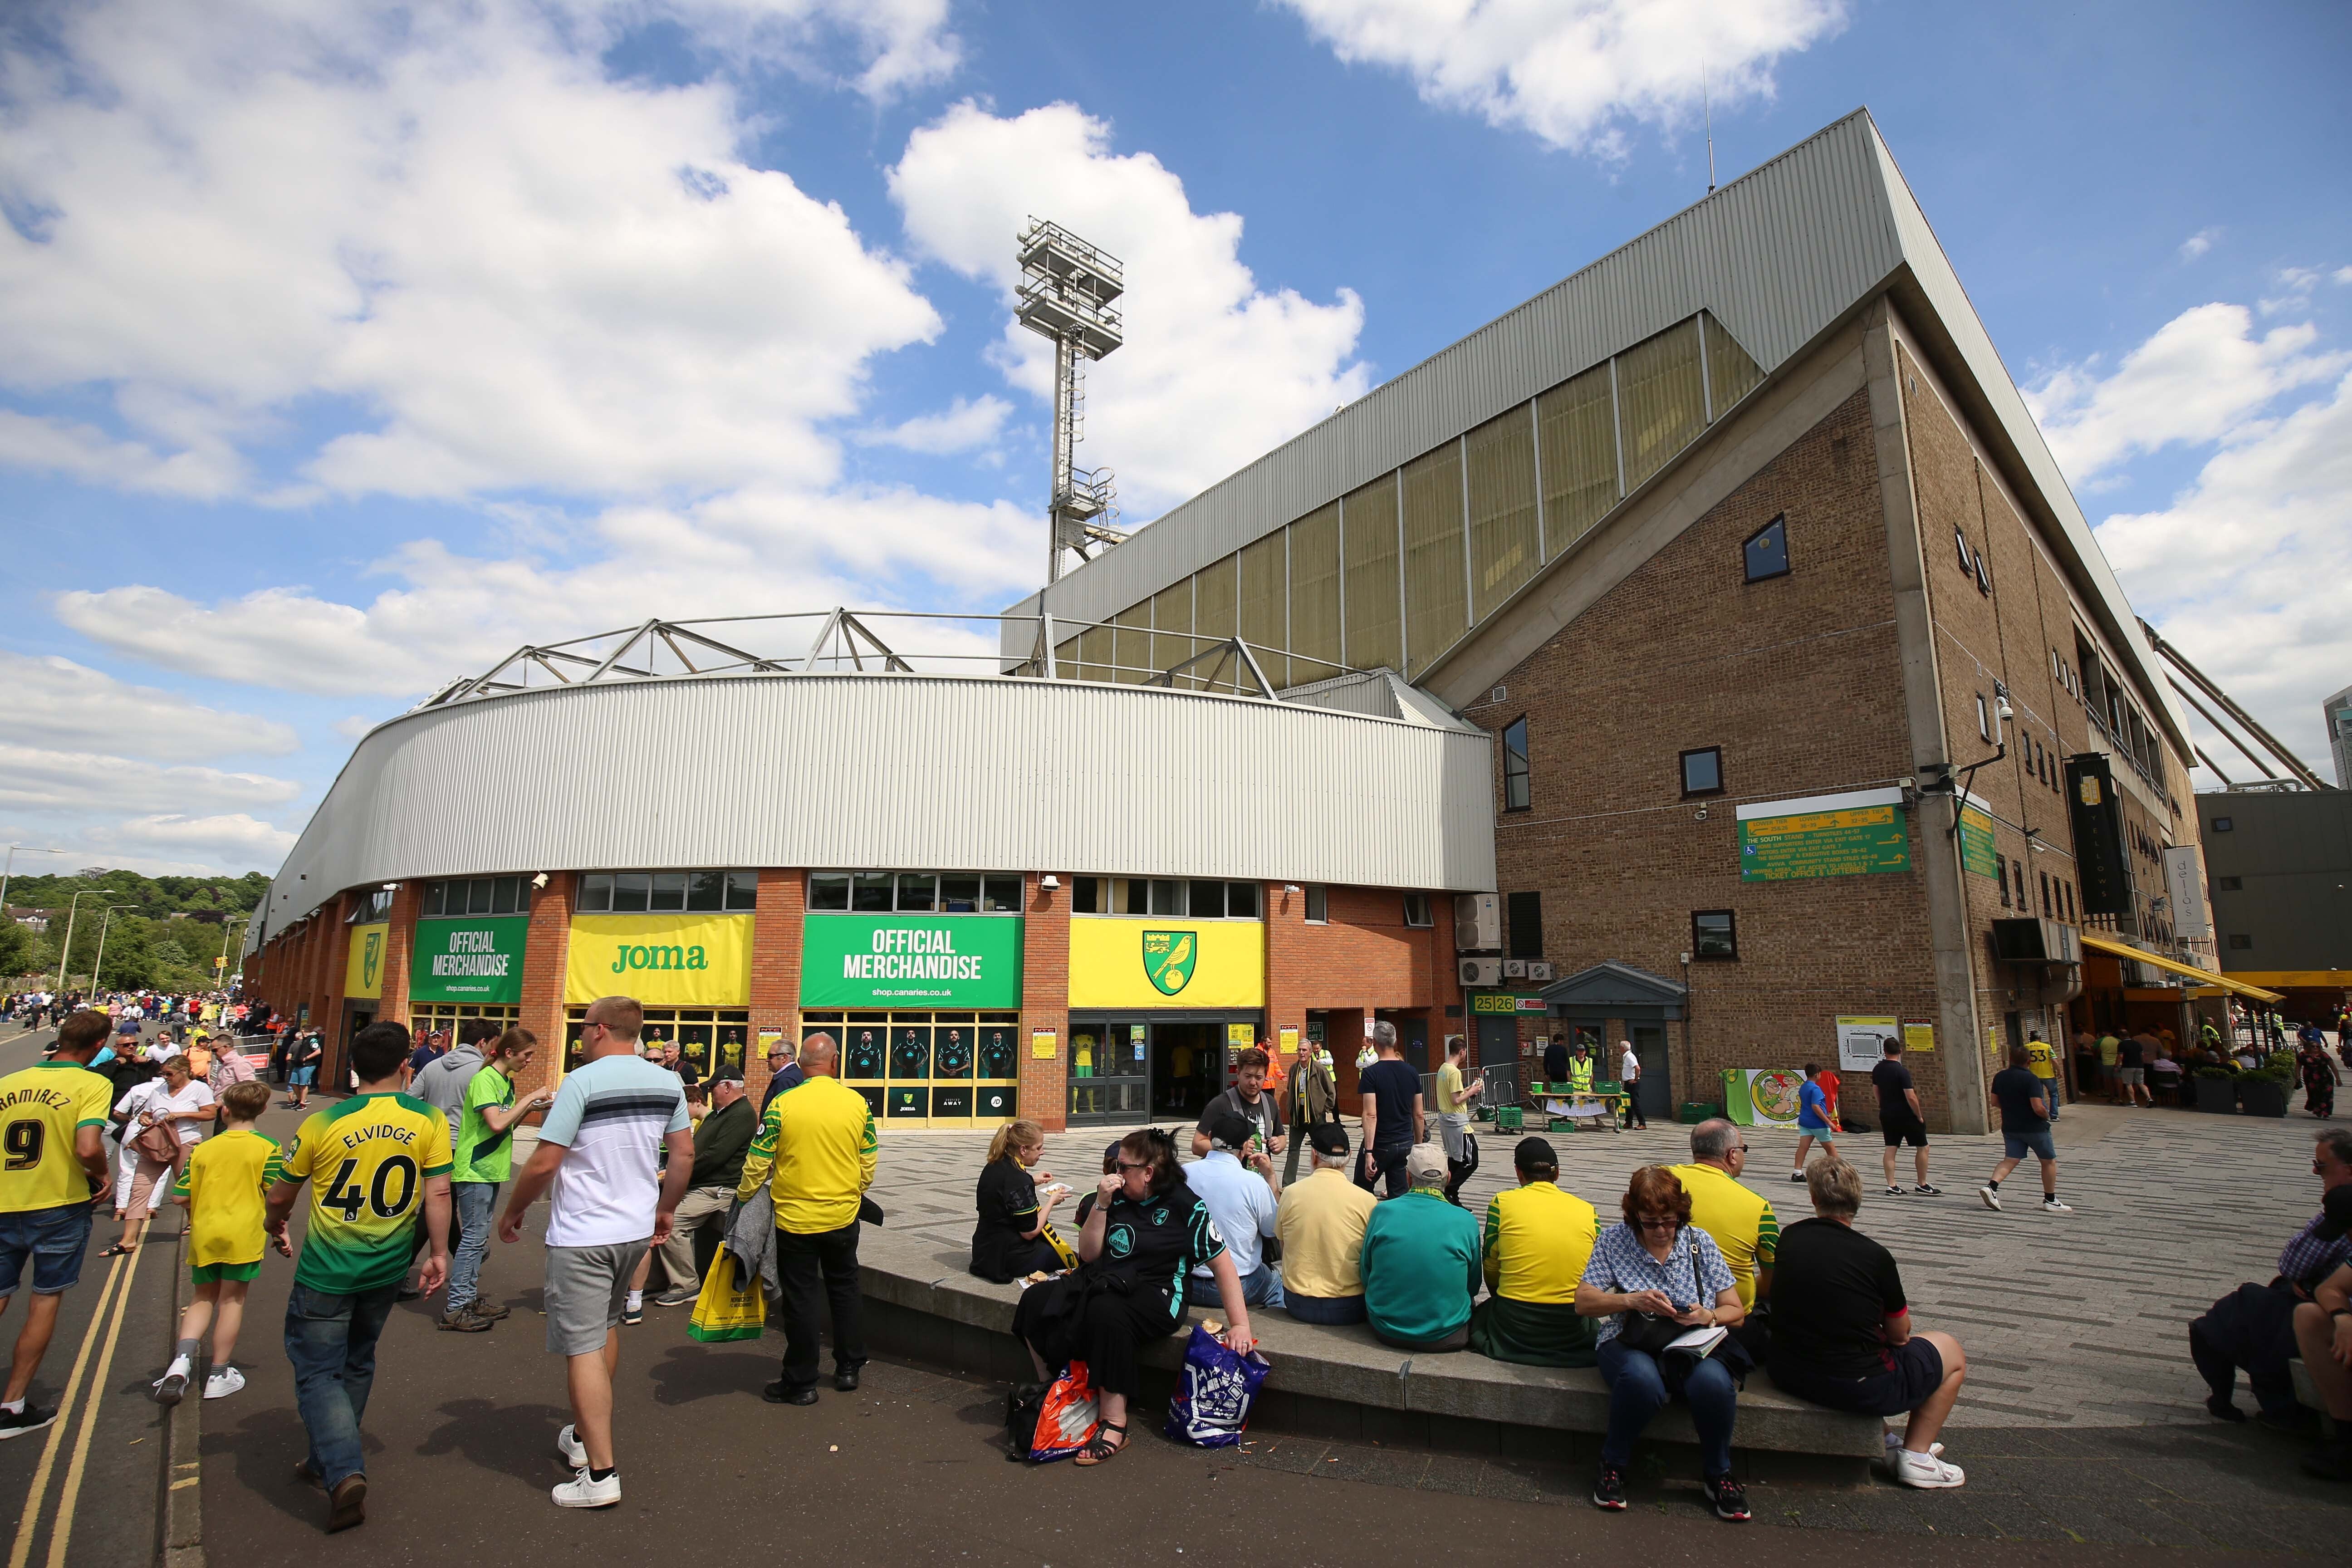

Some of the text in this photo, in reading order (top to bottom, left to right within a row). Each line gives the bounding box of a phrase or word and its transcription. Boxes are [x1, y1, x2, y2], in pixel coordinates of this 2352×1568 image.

[2091, 815, 2107, 897] YELLOWS
[1827, 866, 1867, 875] LOTTERIES
[449, 931, 495, 953] OFFICIAL
[872, 929, 956, 954] OFFICIAL
[432, 954, 510, 976] MERCHANDISE
[843, 954, 982, 980] MERCHANDISE
[872, 988, 951, 997] shop.canaries.co.uk
[1477, 998, 1492, 1009] 25
[1497, 998, 1513, 1009] 26
[2029, 1049, 2046, 1062] 53
[0, 1089, 71, 1111] RAMIREZ
[4, 1119, 44, 1171] 9
[343, 1125, 416, 1149] ELVIDGE
[320, 1154, 417, 1221] 40
[1110, 1237, 1129, 1251] LOTUS
